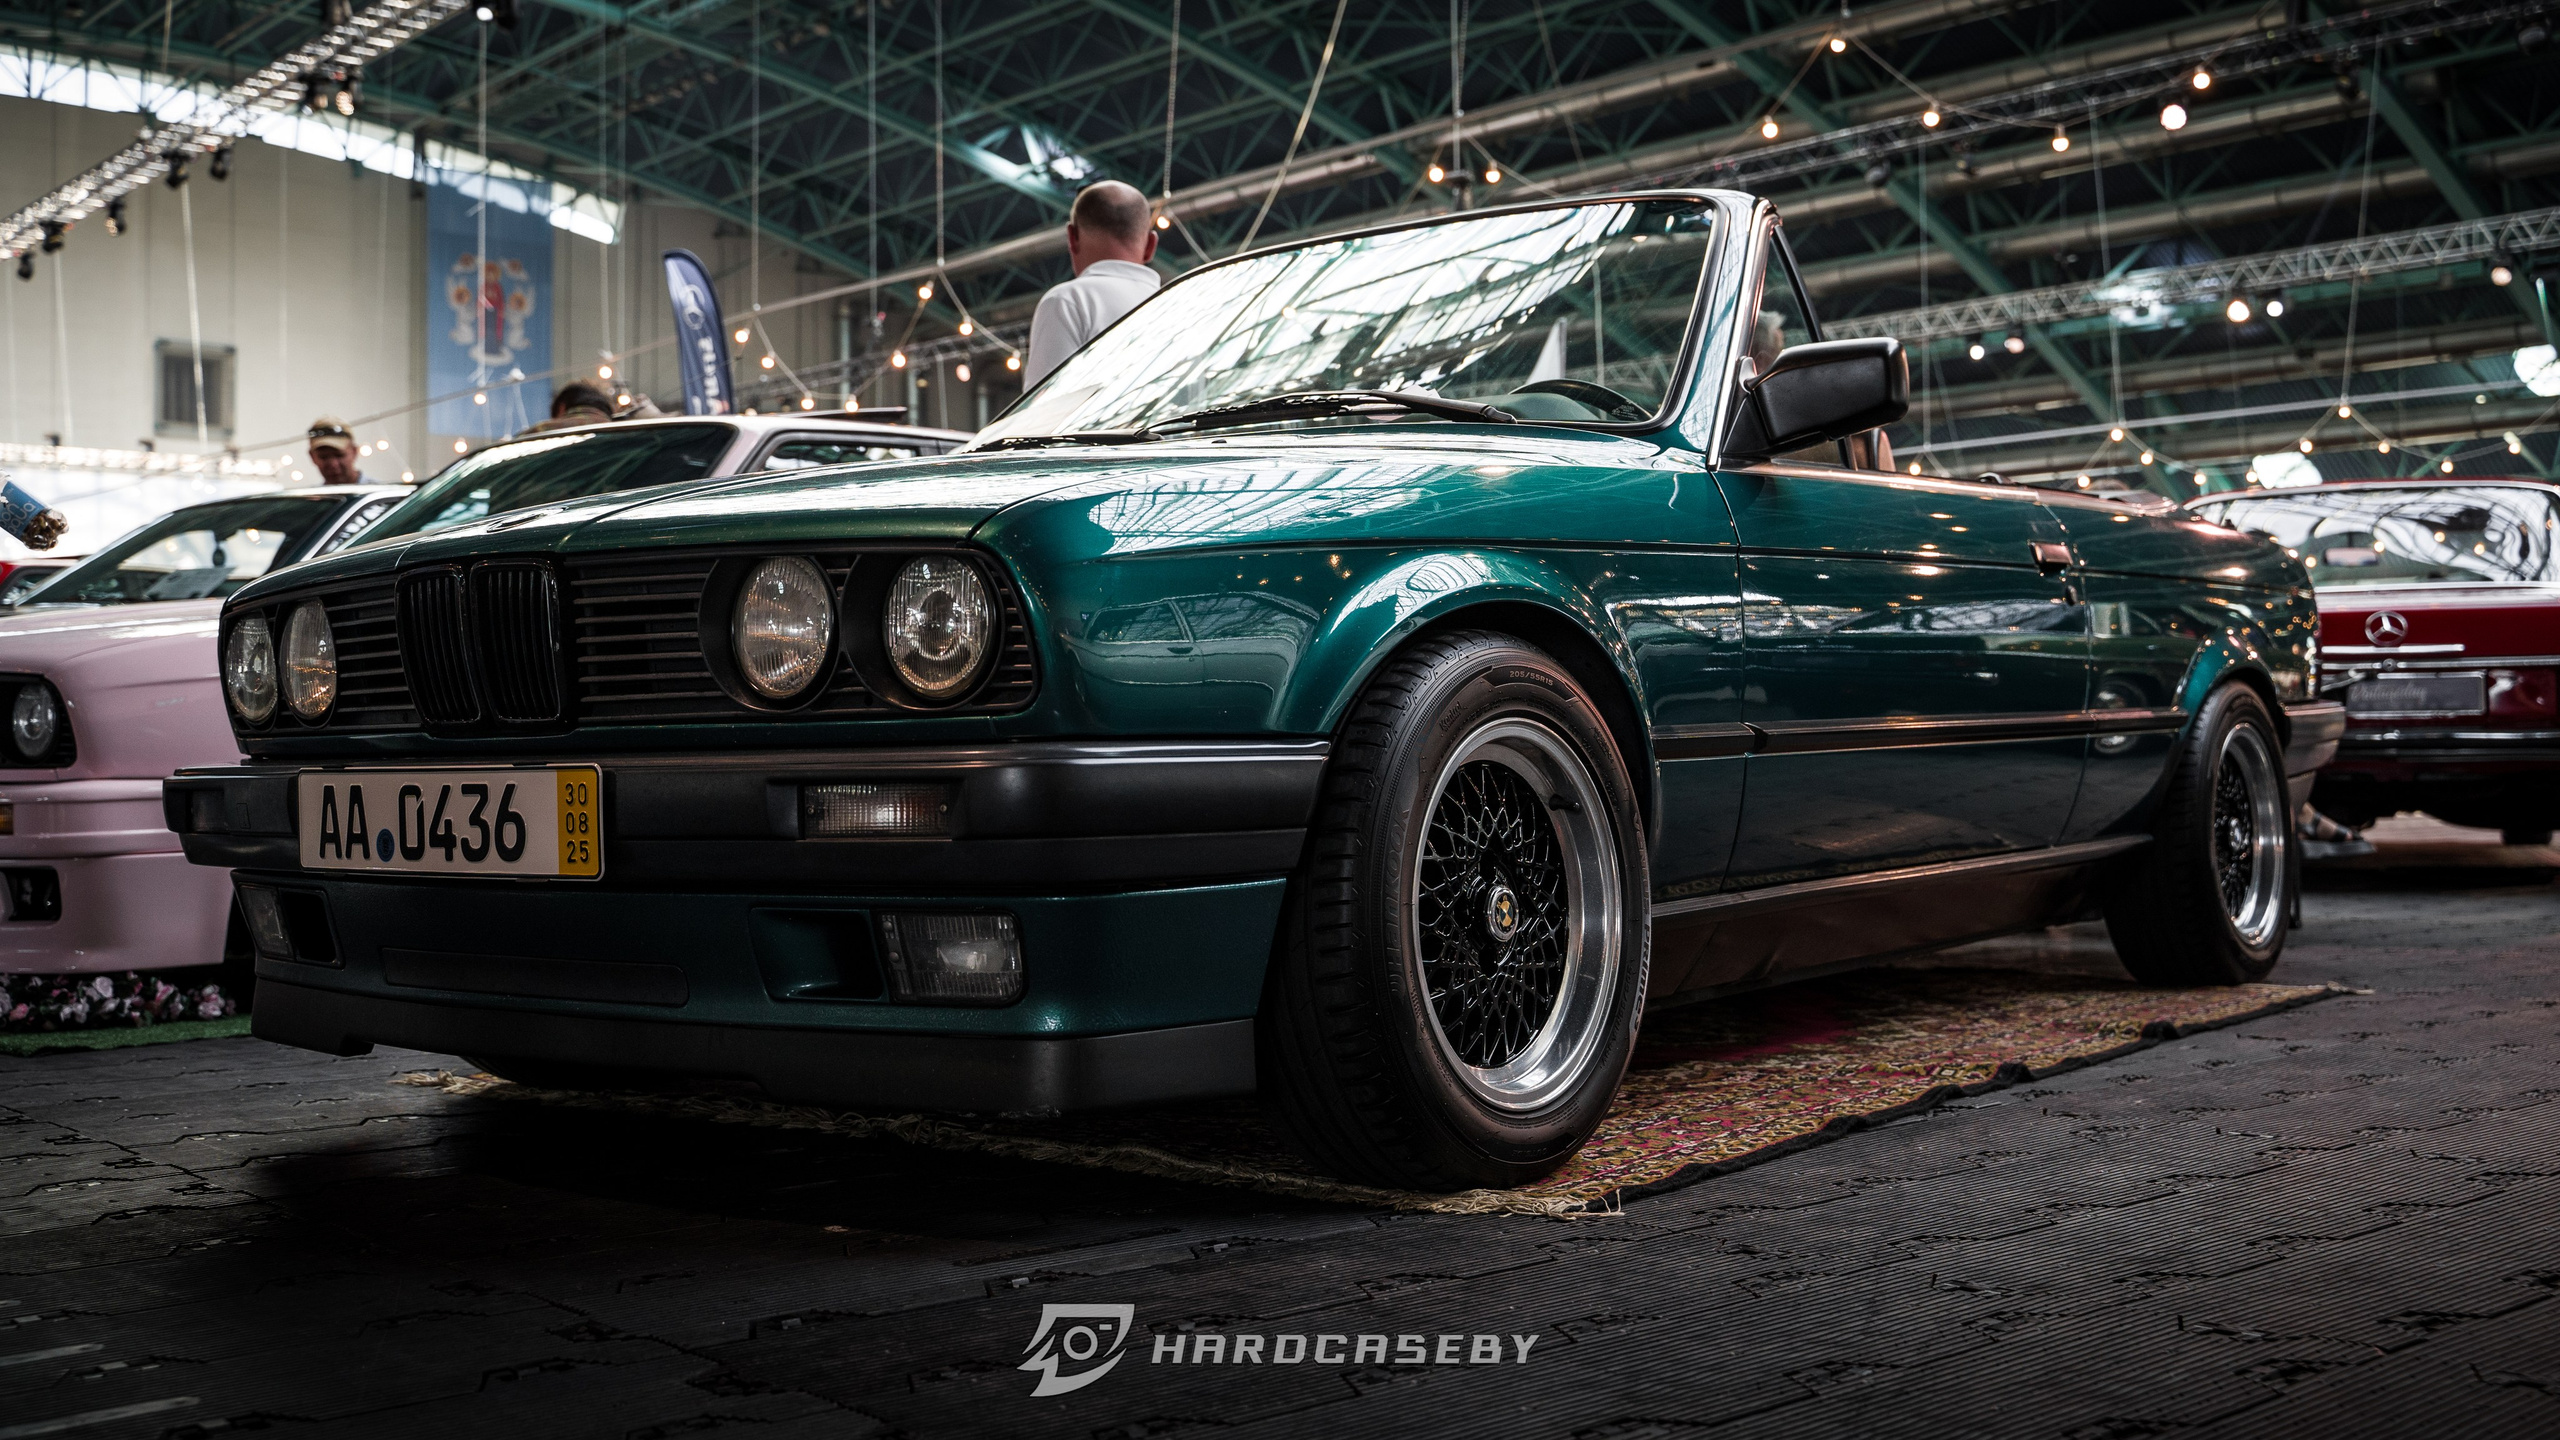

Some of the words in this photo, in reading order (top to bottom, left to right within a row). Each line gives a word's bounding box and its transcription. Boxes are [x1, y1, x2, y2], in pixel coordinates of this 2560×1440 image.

[1509, 670, 1554, 686] 205/55R15
[565, 783, 587, 805] 30
[319, 785, 371, 860] AA
[399, 783, 526, 862] 0436
[565, 812, 589, 834] 08
[567, 840, 589, 863] 25
